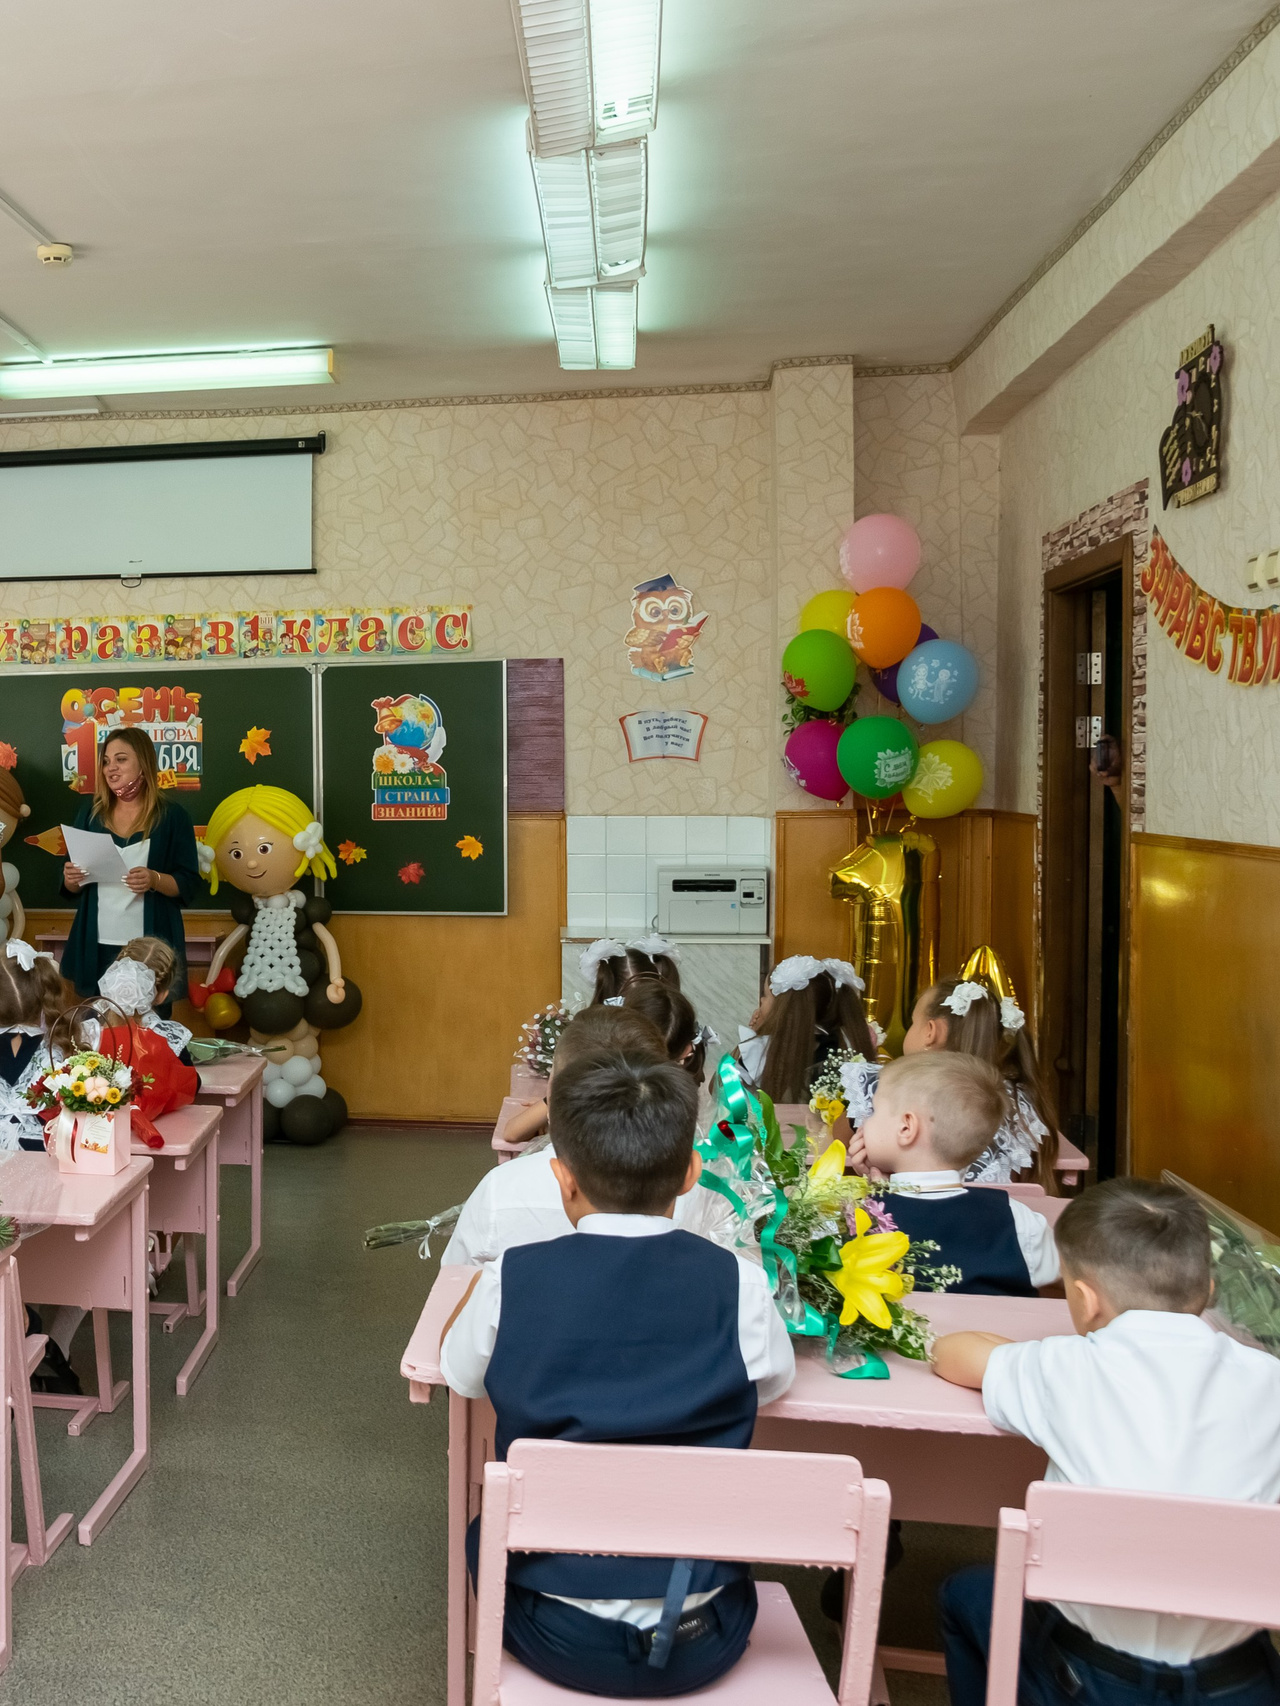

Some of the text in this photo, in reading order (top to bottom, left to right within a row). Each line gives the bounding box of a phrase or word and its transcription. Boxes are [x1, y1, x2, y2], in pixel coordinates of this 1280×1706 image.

[65, 622, 162, 660] раз
[281, 612, 469, 654] класс!
[61, 686, 197, 724] ОСЕНЬ
[384, 790, 441, 802] СТРАНА
[377, 804, 442, 818] ЗНАНИЙ!
